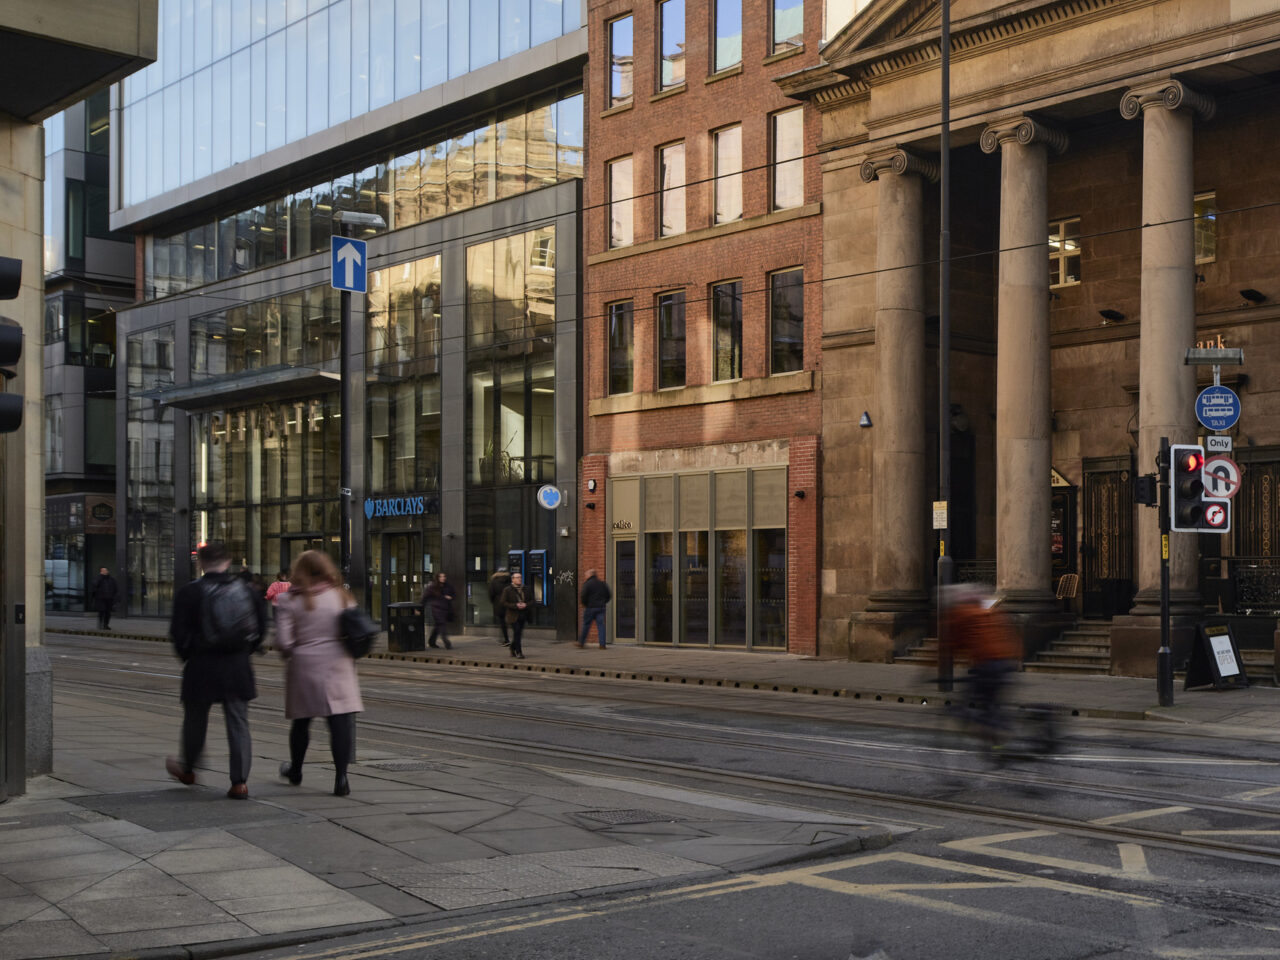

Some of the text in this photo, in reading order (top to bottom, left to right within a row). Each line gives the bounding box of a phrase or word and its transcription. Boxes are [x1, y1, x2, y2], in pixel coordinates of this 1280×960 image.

[1196, 334, 1226, 350] ank
[1211, 419, 1226, 427] TAXI
[1210, 439, 1230, 449] Only
[375, 496, 424, 517] BARCLAYS
